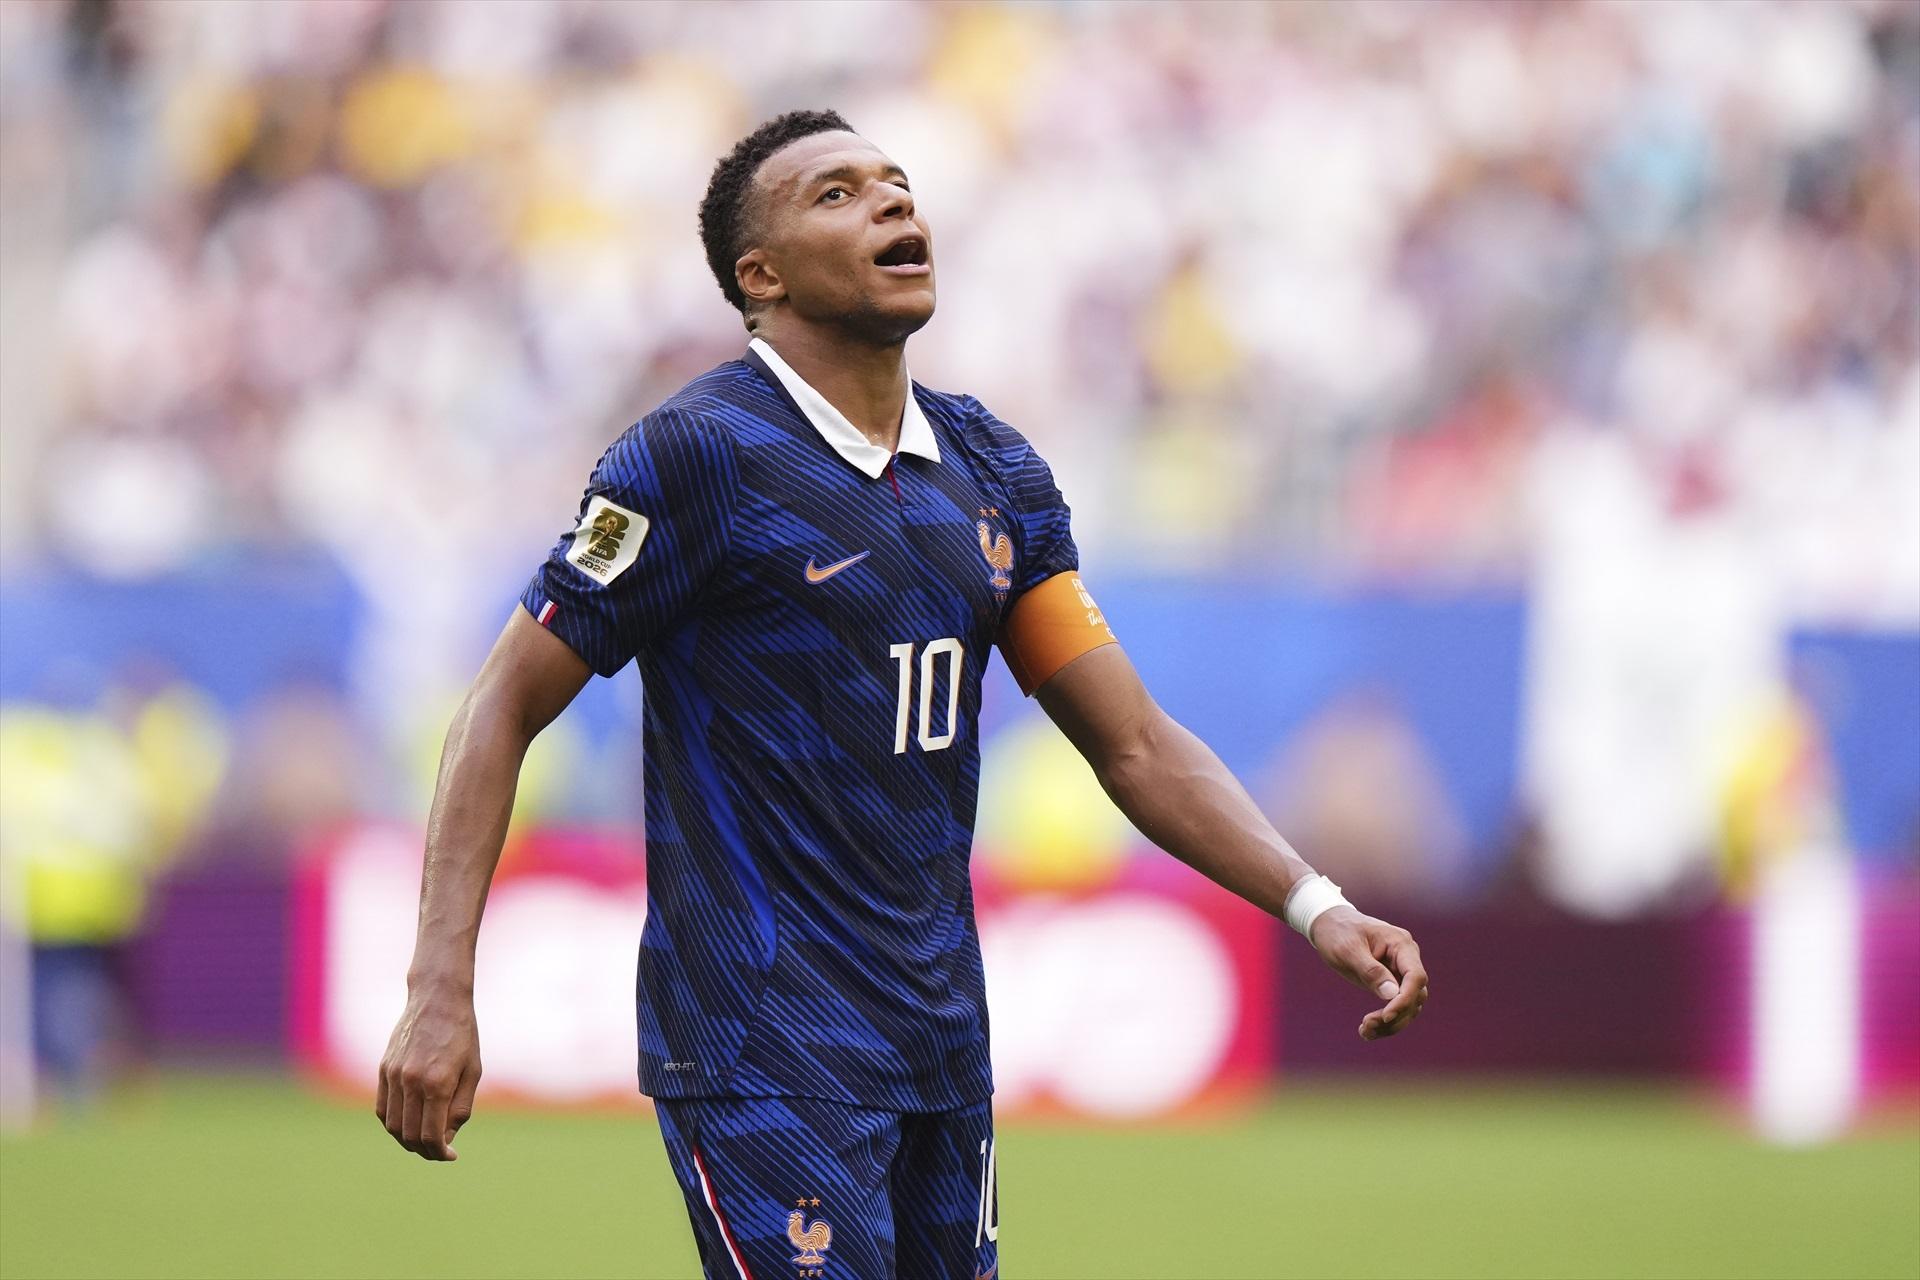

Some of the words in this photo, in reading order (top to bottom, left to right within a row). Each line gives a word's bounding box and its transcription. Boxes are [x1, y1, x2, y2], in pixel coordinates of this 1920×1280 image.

[592, 545, 608, 556] FIFA
[577, 557, 608, 577] 2026
[600, 560, 611, 569] CUP
[890, 638, 964, 754] 10
[799, 1269, 823, 1278] FFF
